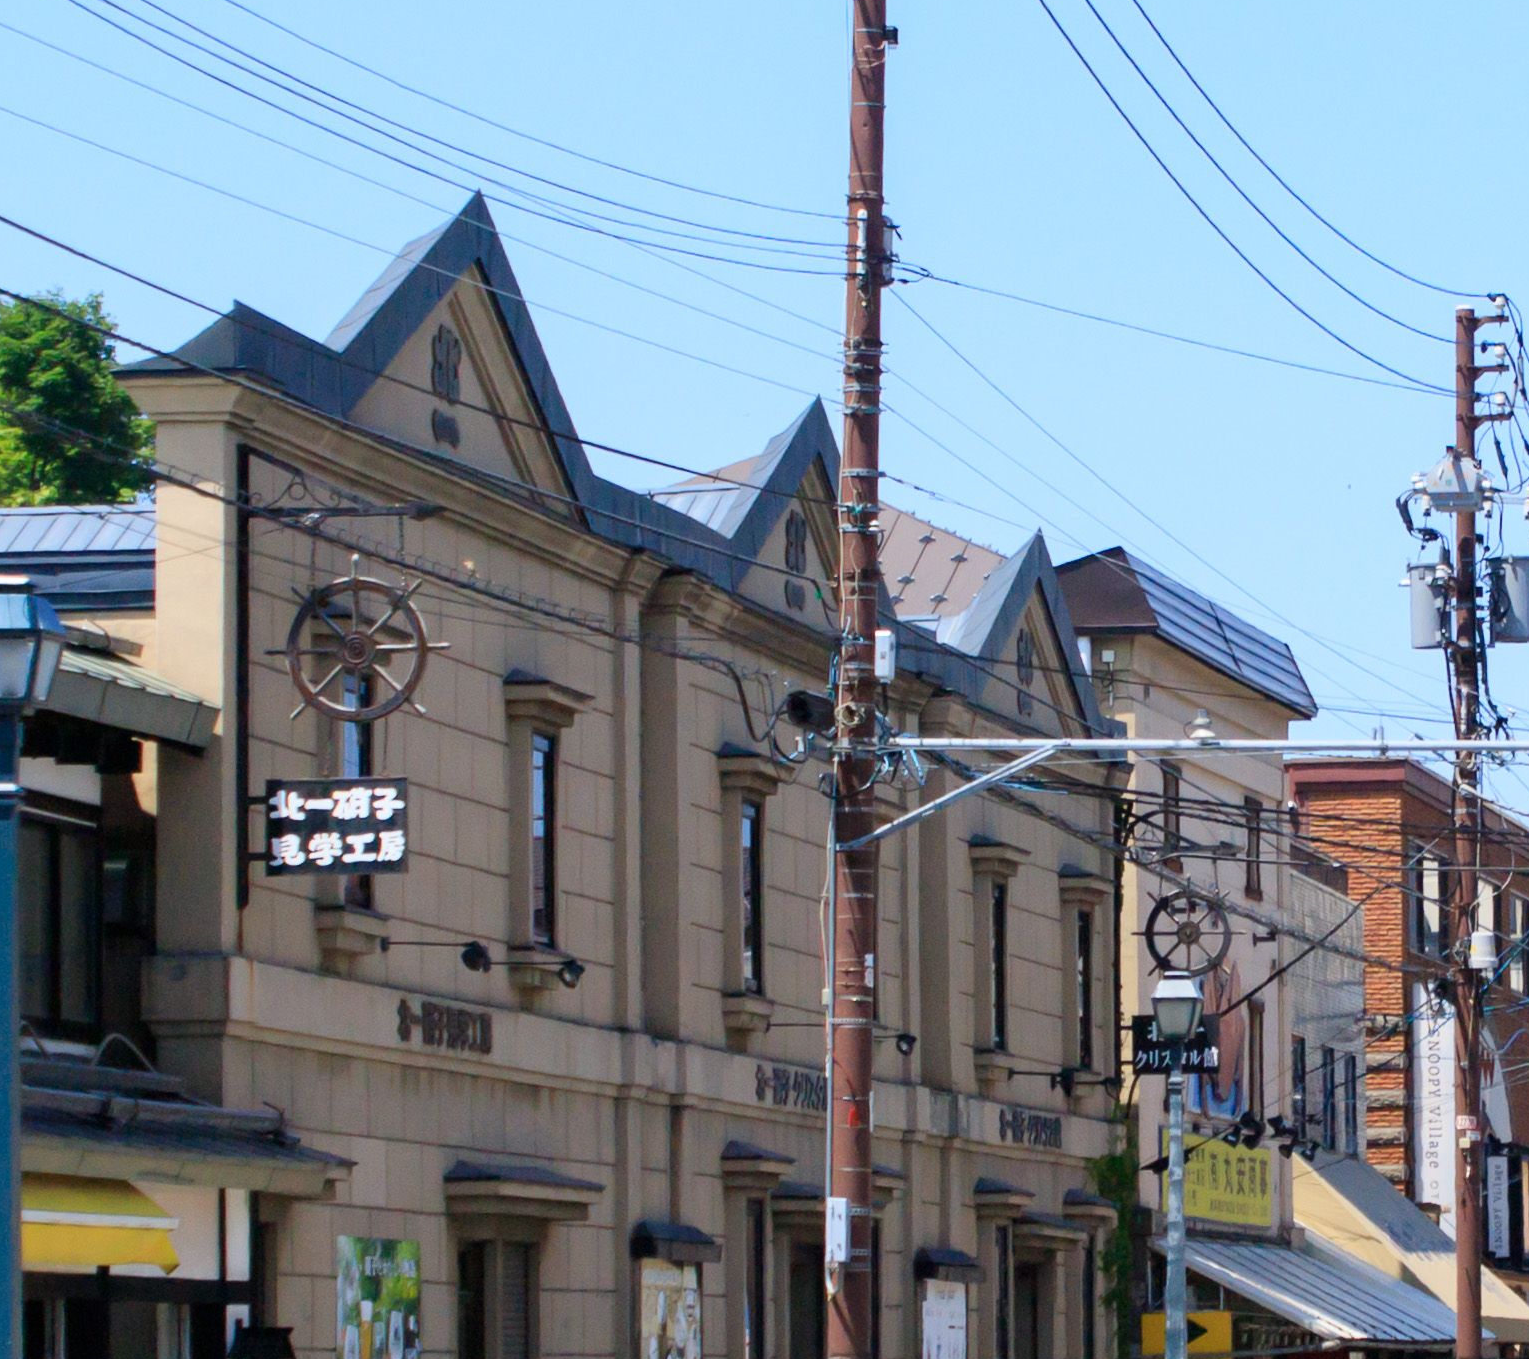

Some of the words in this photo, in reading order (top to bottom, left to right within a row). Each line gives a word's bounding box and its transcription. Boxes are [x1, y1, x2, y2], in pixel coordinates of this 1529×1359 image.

[269, 787, 405, 820] 北一硝子
[269, 830, 405, 866] 見学工房
[1135, 1046, 1219, 1069] クリスル館
[1425, 1105, 1440, 1168] Village
